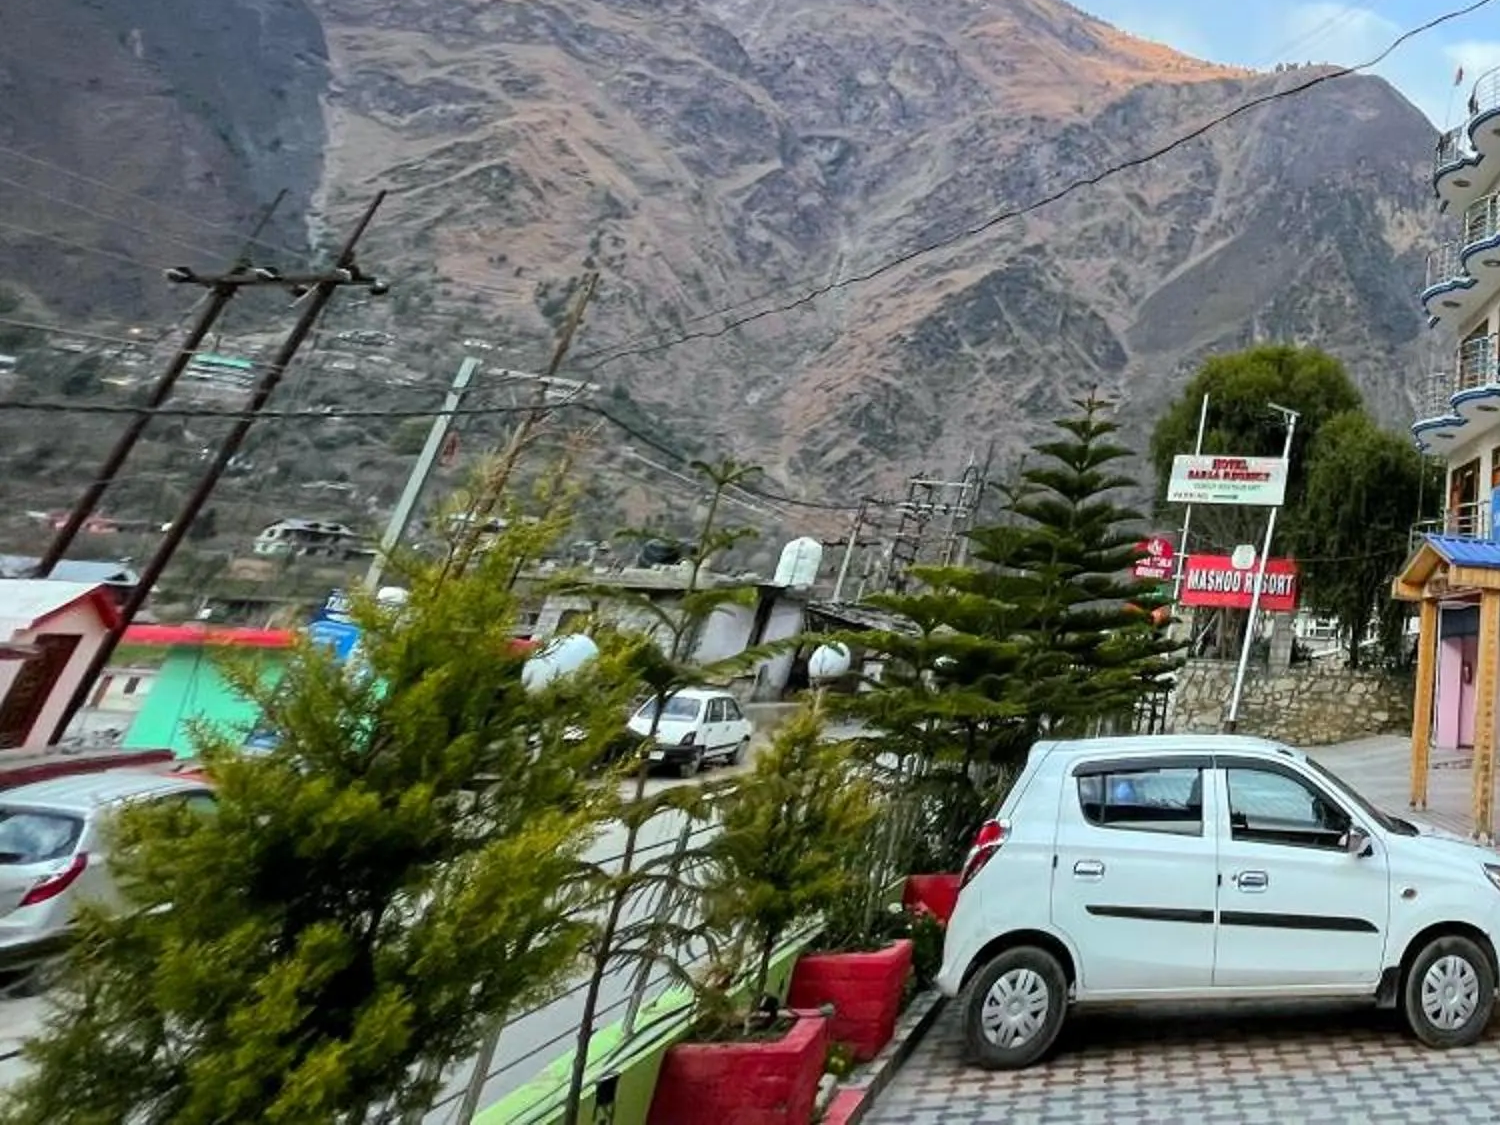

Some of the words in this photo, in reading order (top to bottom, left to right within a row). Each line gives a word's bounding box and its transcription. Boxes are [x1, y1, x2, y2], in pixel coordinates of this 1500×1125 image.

[1212, 458, 1248, 469] HOTEL
[1188, 568, 1240, 592] MASHOO
[1244, 572, 1293, 595] RSORT
